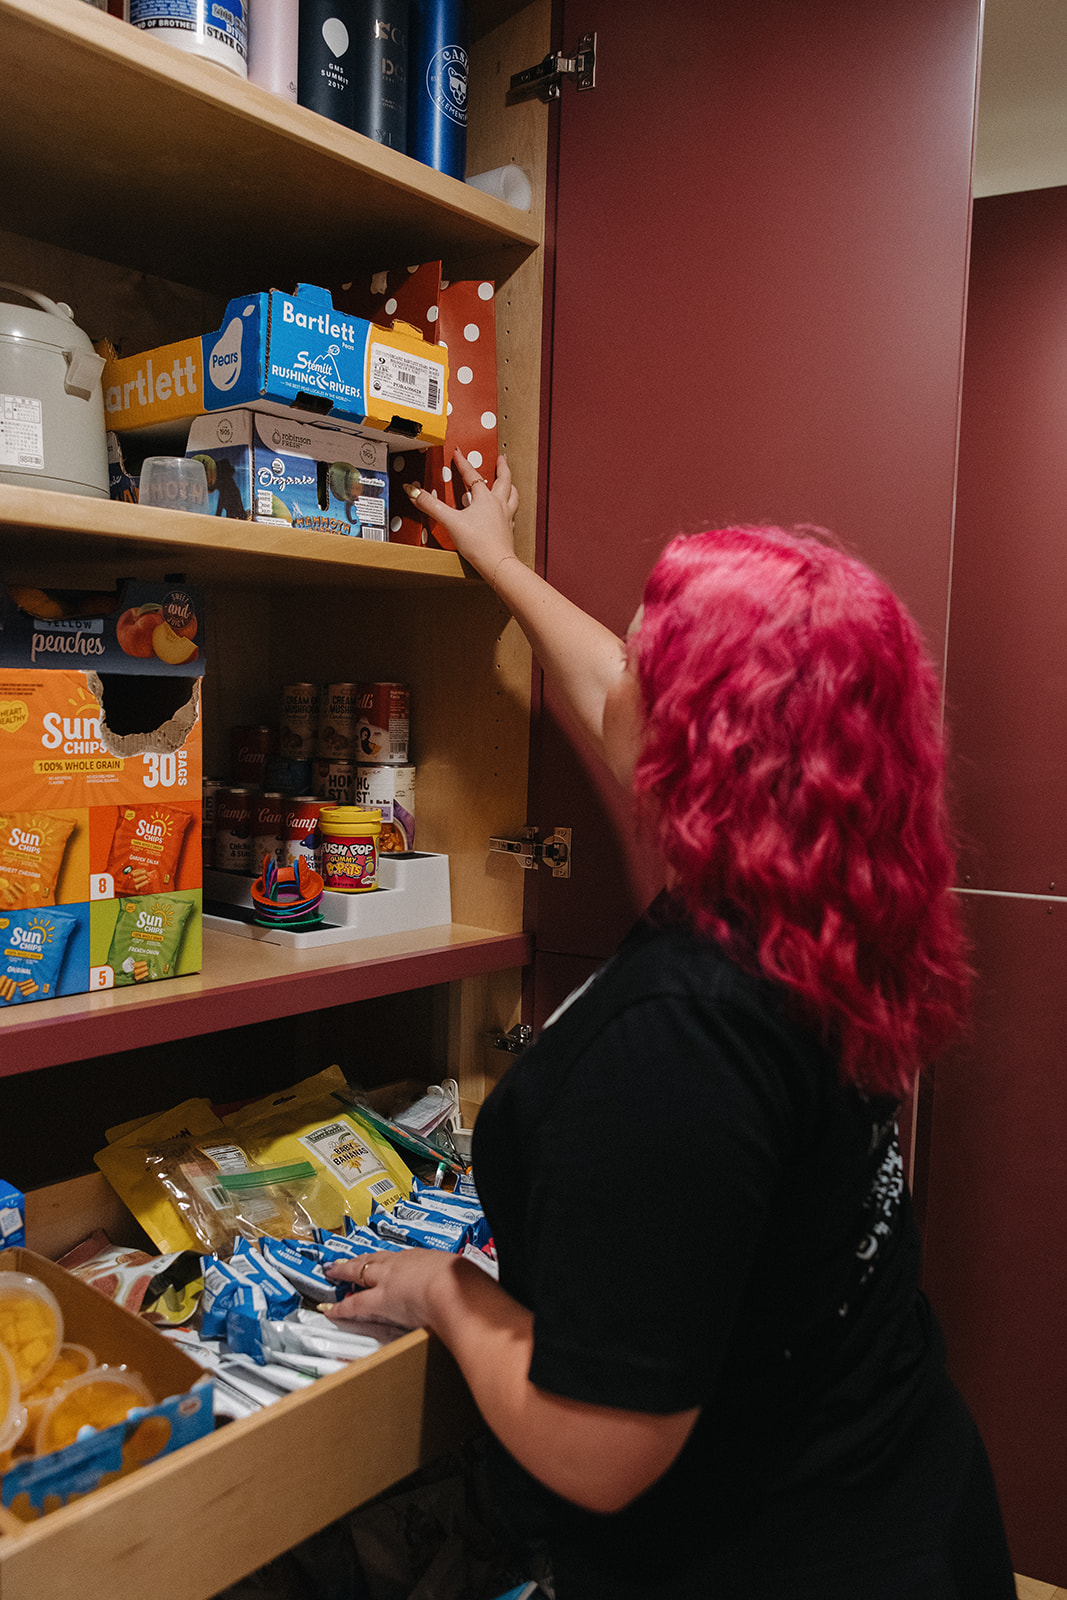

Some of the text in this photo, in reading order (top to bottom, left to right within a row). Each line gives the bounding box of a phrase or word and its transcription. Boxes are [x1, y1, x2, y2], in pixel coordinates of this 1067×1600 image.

[159, 19, 197, 31] BROTHER
[207, 26, 234, 49] STATE
[328, 63, 344, 74] GMS
[321, 69, 349, 85] SUMMIT
[328, 80, 345, 91] 2017
[283, 300, 355, 343] Bartlett
[341, 342, 355, 351] Pears
[212, 352, 239, 368] Pears
[293, 351, 333, 376] Stemilt
[106, 357, 197, 413] artlett
[271, 364, 316, 386] RUSHING
[329, 380, 361, 398] RIVERS
[282, 433, 312, 446] robinson
[282, 440, 303, 448] FRESH
[257, 467, 315, 491] Organic
[295, 516, 351, 534] MAMMOTH
[168, 603, 190, 619] and
[31, 630, 106, 663] peaches
[0, 714, 26, 725] EALTHY
[1, 707, 22, 718] HEART
[41, 712, 103, 749] Sun
[63, 740, 107, 755] CHIPS
[237, 747, 266, 766] Cam
[38, 760, 121, 772] 100% WHOLE GRAIN
[143, 753, 177, 788] 30
[178, 750, 188, 787] BAGS
[357, 777, 370, 791] HO
[356, 791, 370, 804] ST
[135, 819, 163, 837] Sun
[286, 812, 319, 832] Camp
[9, 828, 40, 847] Sun
[144, 834, 163, 844] CHIPS
[18, 843, 41, 854] CHIPS
[349, 843, 375, 857] POP
[330, 856, 357, 864] GUMMY
[98, 877, 107, 894] 8
[136, 911, 163, 928] Sun
[10, 926, 42, 946] Sun
[144, 925, 163, 935] CHIPS
[19, 942, 42, 952] CHIPS
[98, 970, 107, 986] 5
[333, 1142, 354, 1155] BABY
[333, 1147, 369, 1166] BANANAS
